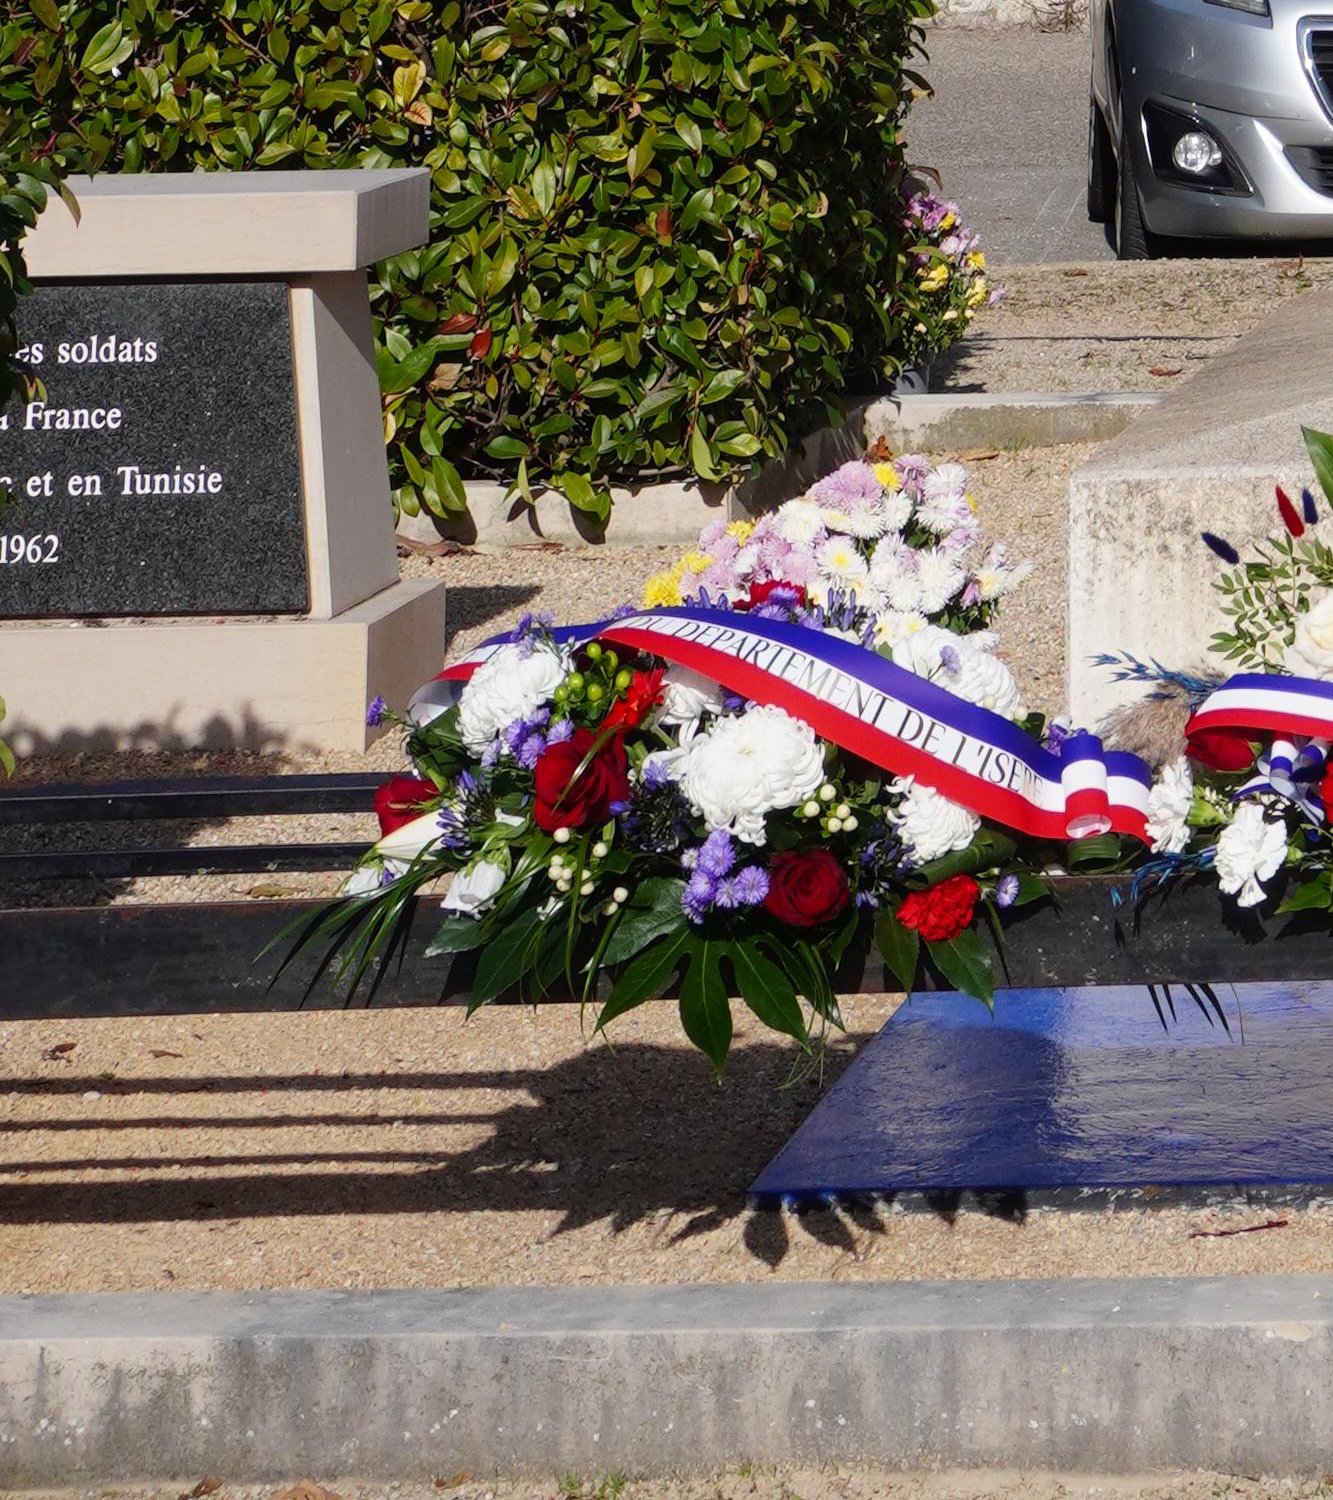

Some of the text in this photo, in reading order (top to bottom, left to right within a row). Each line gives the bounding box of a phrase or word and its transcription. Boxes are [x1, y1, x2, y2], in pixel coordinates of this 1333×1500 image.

[57, 334, 158, 364] soldats
[22, 401, 122, 431] France
[26, 471, 53, 497] et
[67, 474, 102, 496] en
[117, 464, 223, 495] Tunisie
[0, 534, 60, 564] 1962
[626, 617, 675, 632] DU
[671, 621, 894, 726] DEPARTEMENT
[896, 709, 946, 757] DE
